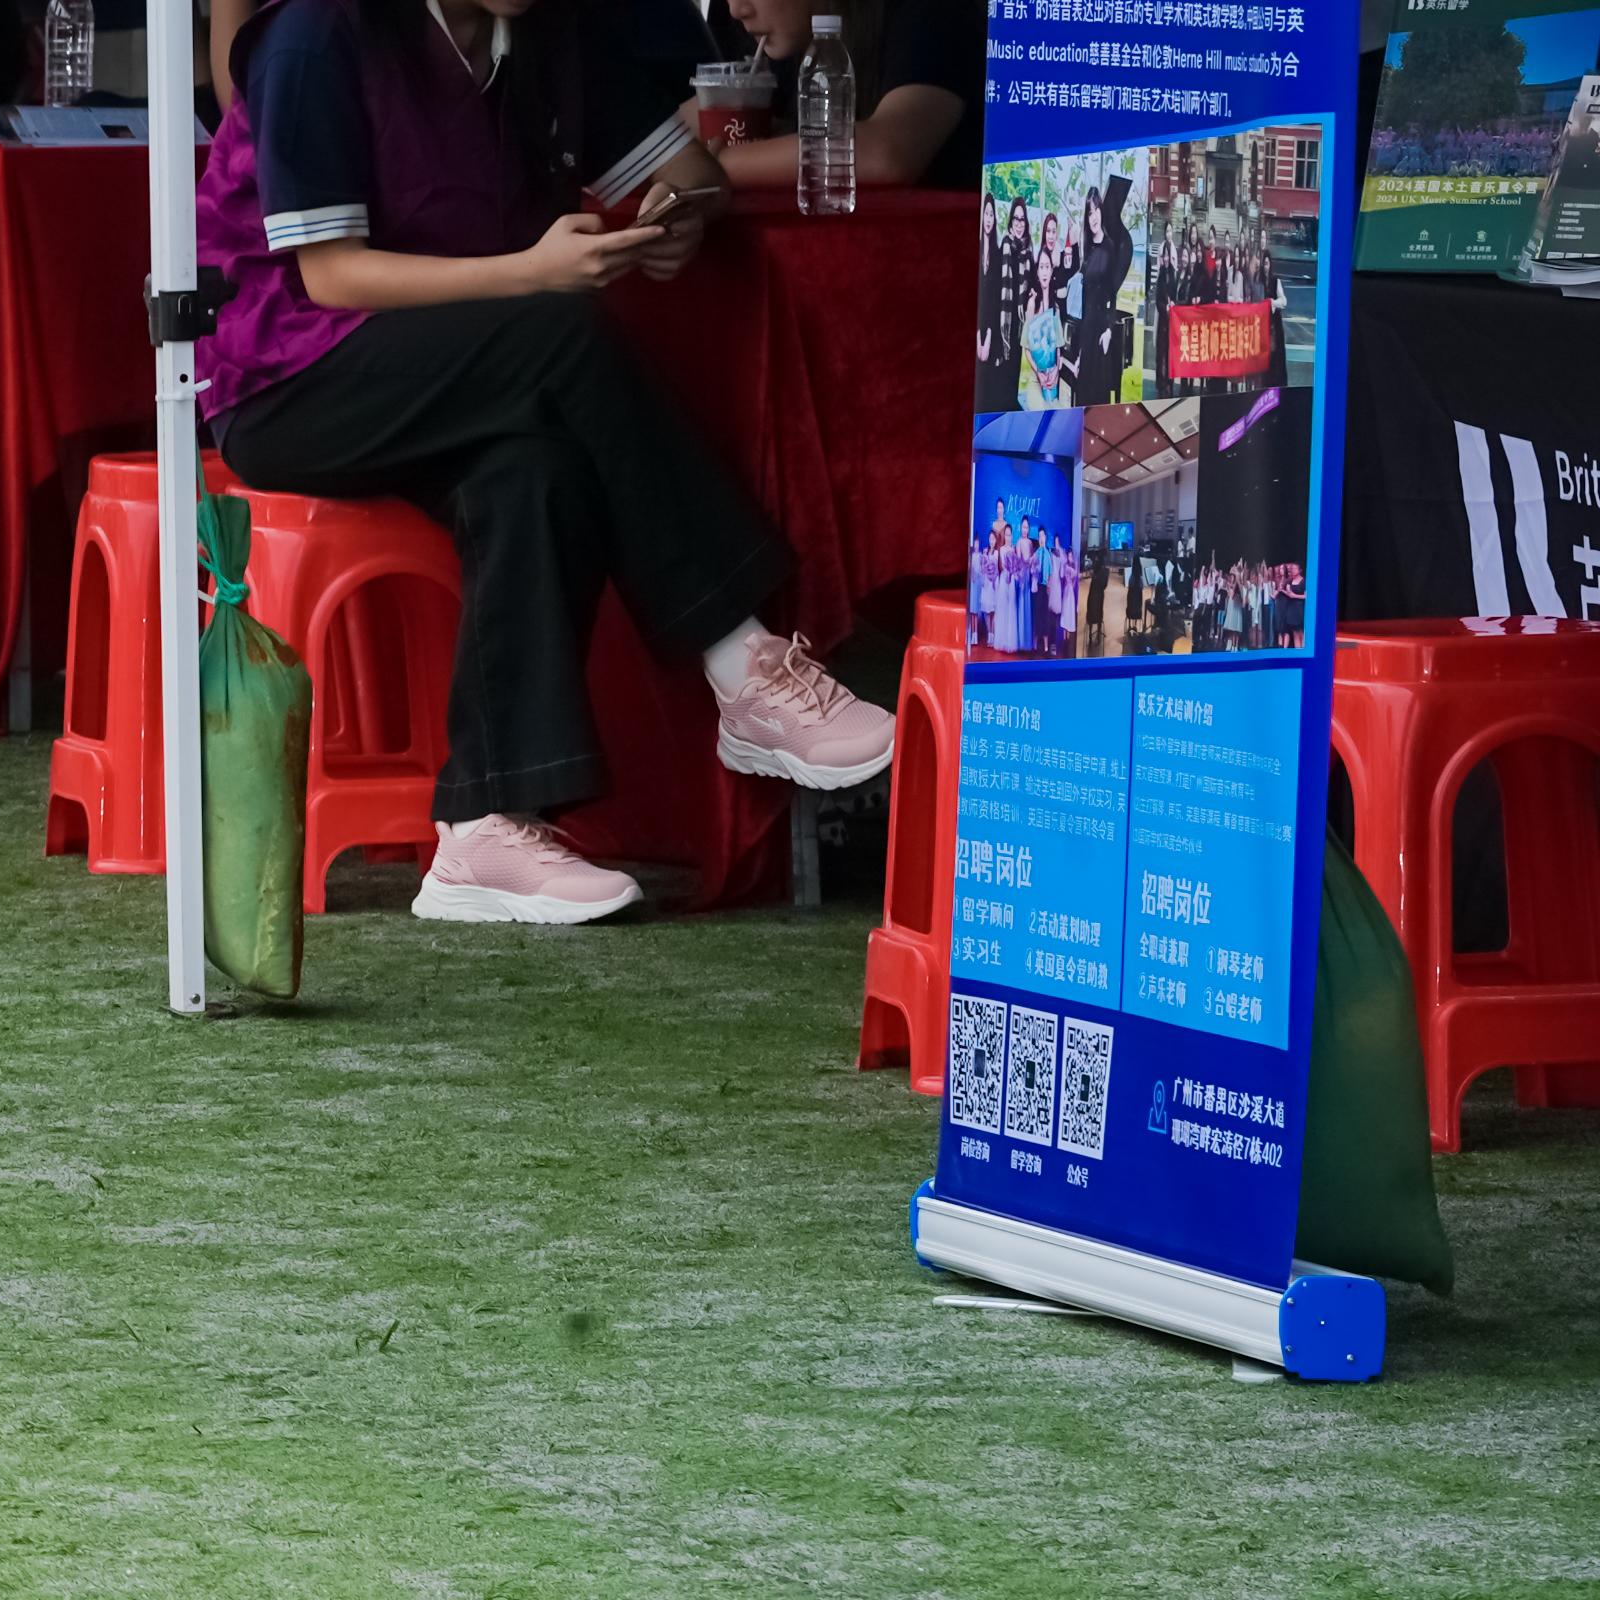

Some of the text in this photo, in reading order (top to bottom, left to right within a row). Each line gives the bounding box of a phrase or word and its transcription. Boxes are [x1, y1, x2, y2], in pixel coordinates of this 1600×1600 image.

[1206, 49, 1222, 70] Hill
[1225, 52, 1247, 72] music
[1376, 194, 1521, 205] 2024 UK Music Summer School
[1377, 179, 1538, 194] 2024英国本土音乐夏令营
[1138, 692, 1213, 726] 英乐艺术培训介绍
[1141, 870, 1211, 925] 招聘岗位
[1140, 932, 1189, 967] 全职或兼职
[1173, 1077, 1285, 1128] 广州市番禺区沙溪大道
[1171, 1118, 1283, 1168] 珊瑚湾畔宏涛径7栋402
[961, 1136, 1088, 1188] 岗位咨询 留学咨询 公众号
